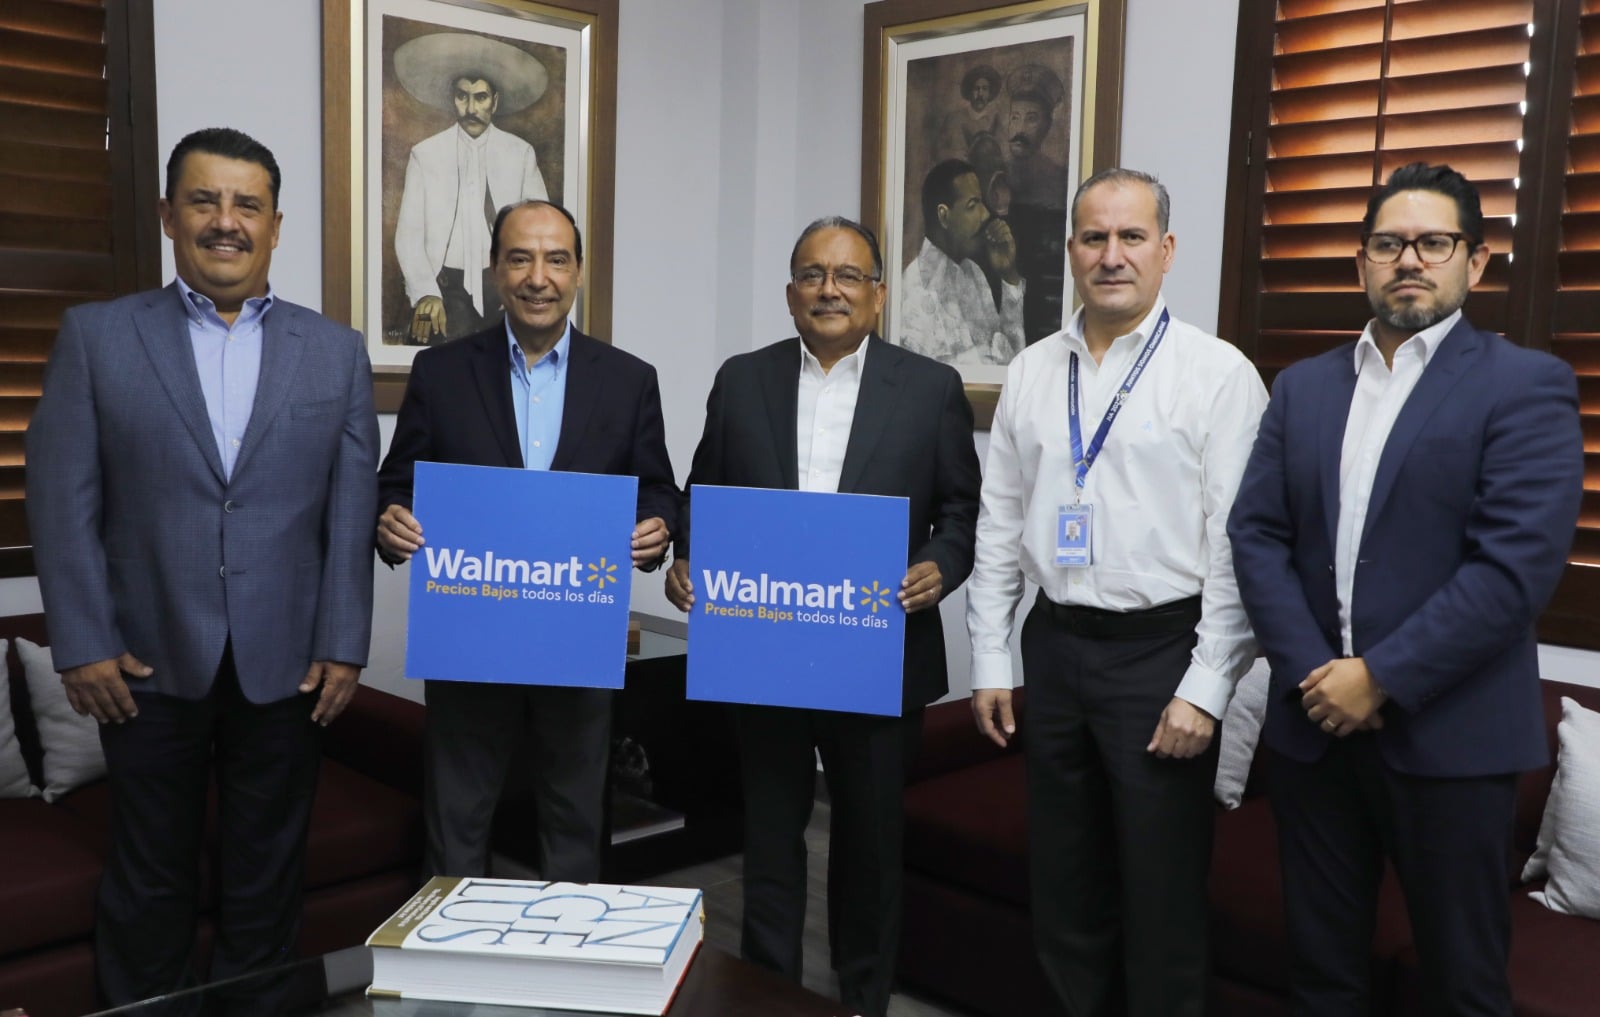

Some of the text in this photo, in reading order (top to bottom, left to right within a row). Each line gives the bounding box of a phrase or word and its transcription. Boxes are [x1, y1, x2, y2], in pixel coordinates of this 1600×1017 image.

[425, 547, 583, 588] Walmart
[426, 580, 615, 604] Precios Bajos todos los días
[703, 569, 856, 611] Walmart
[705, 602, 888, 629] Precios Bajos todos los días
